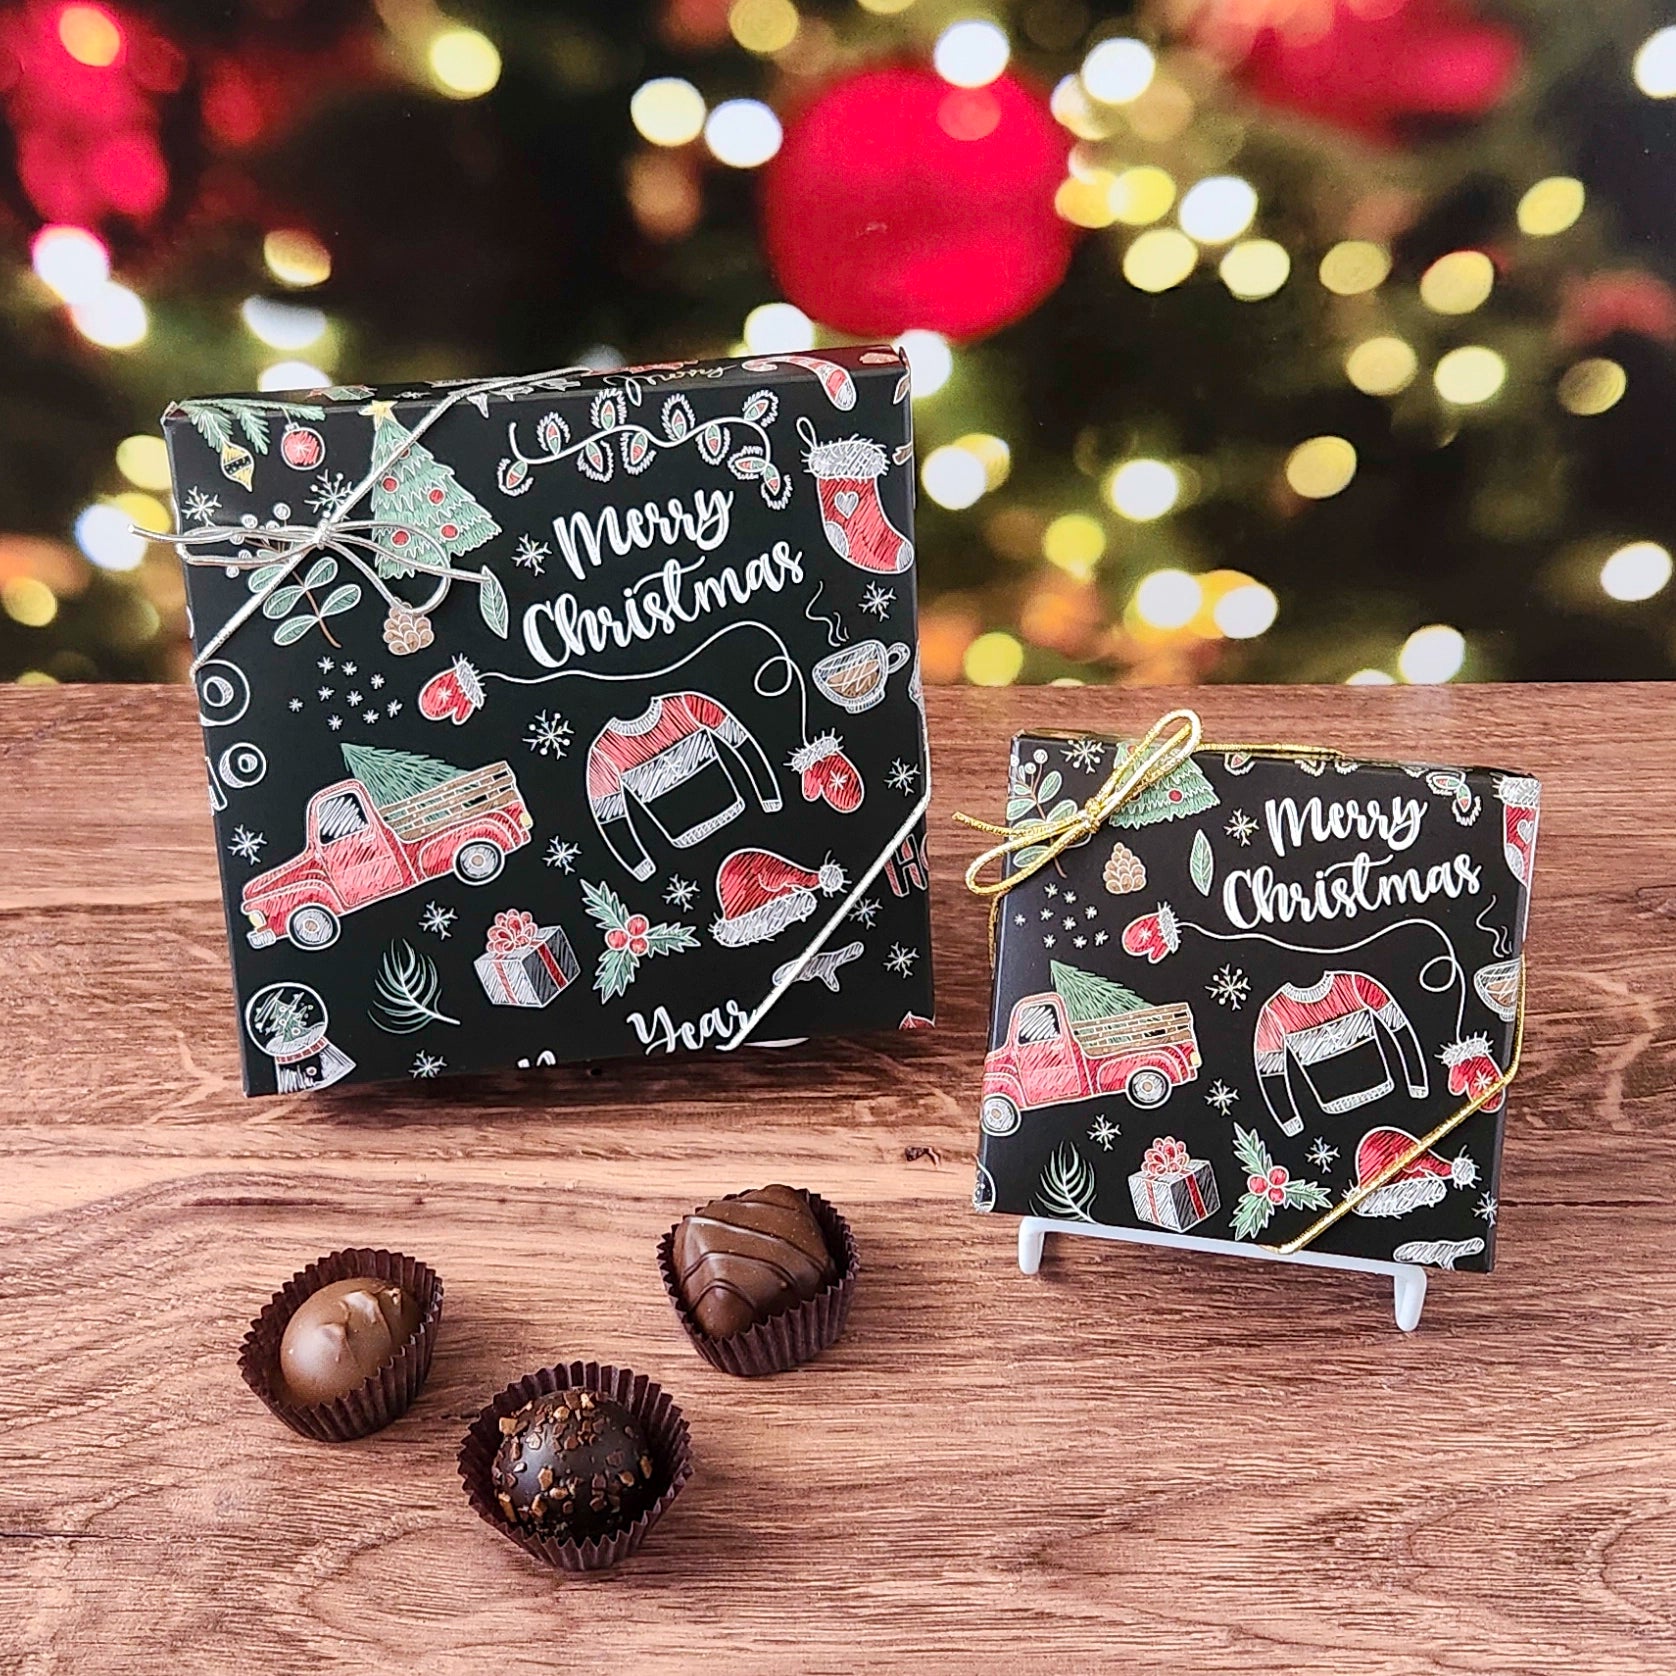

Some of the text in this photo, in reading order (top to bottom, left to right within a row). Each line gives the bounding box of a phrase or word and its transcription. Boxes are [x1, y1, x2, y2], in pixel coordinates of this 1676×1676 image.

[553, 489, 734, 580] Merry
[522, 541, 804, 668] Christmas
[1265, 796, 1428, 857] Merry
[1223, 852, 1482, 929] Christmas
